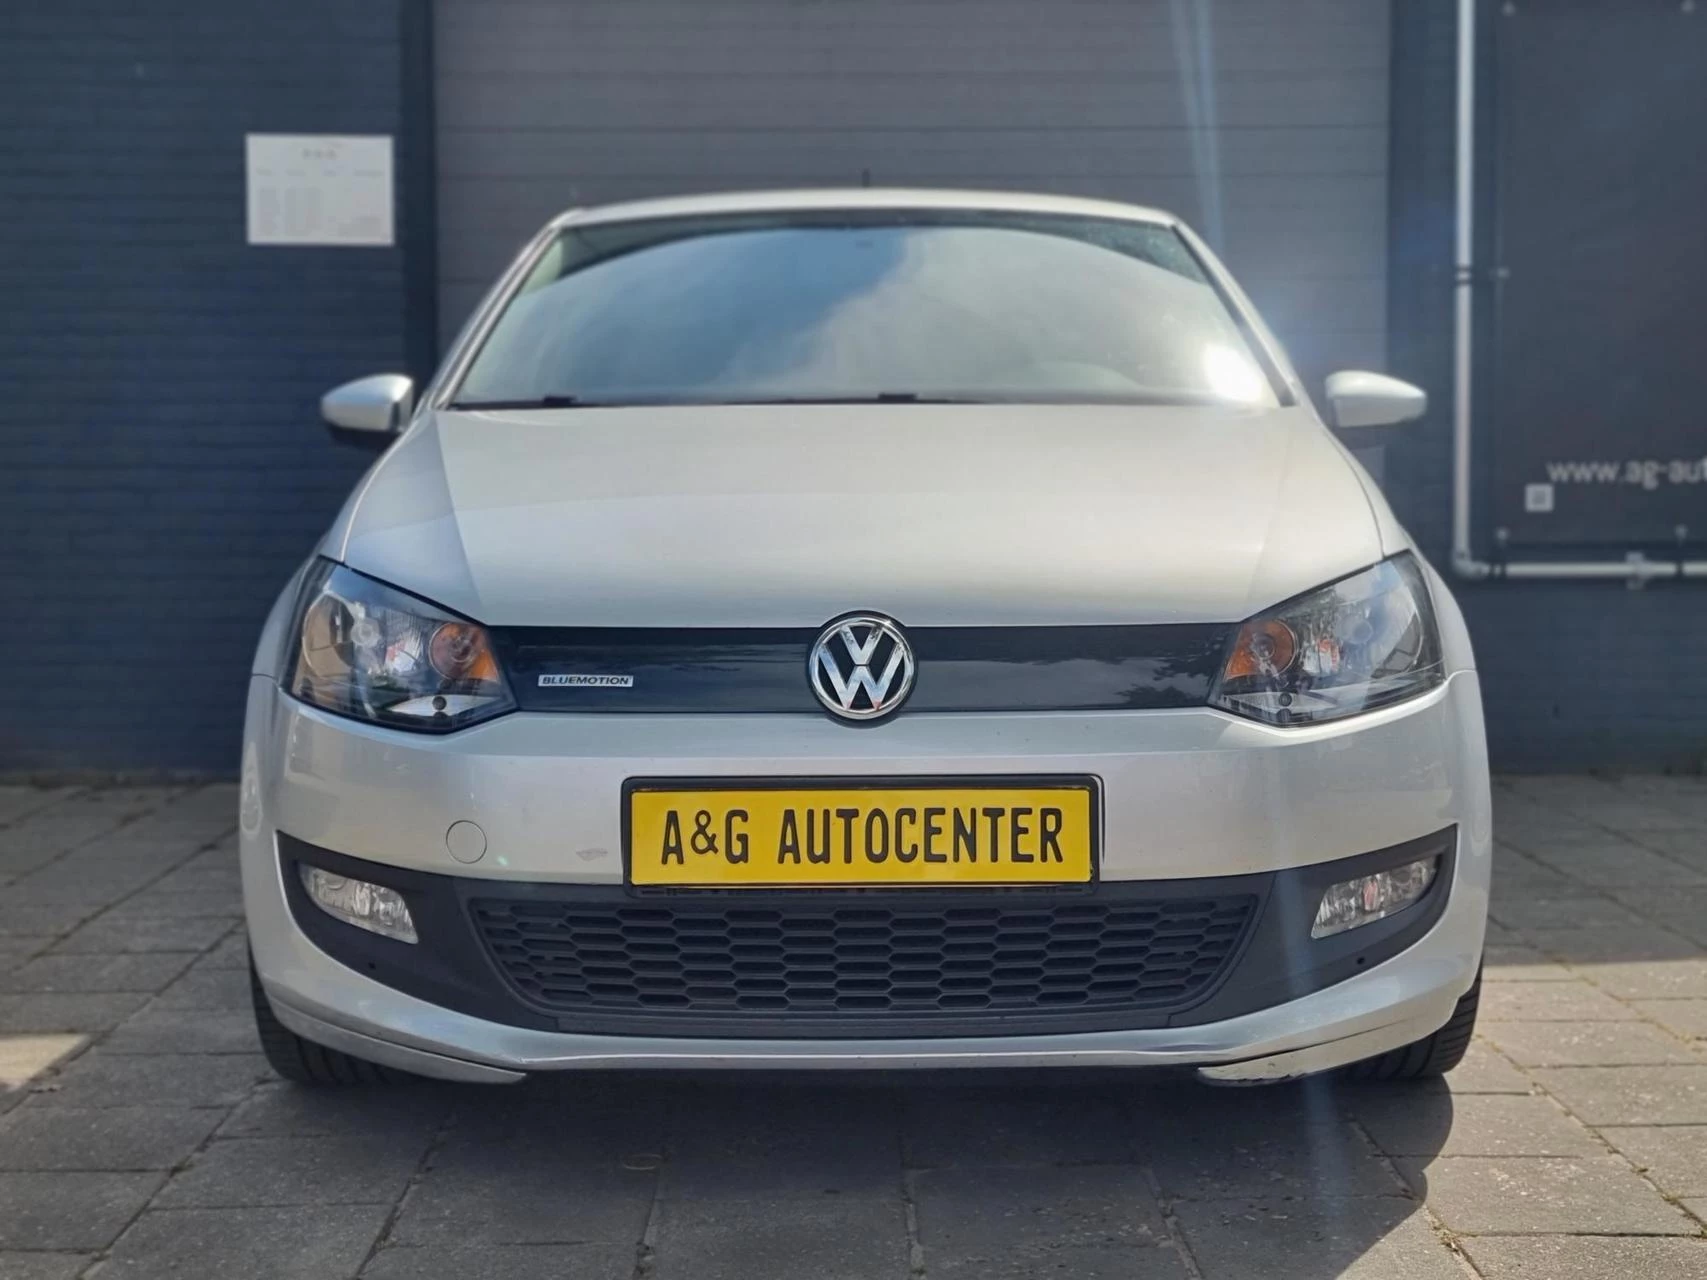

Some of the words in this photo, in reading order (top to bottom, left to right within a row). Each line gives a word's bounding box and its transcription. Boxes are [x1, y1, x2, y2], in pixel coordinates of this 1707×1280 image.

[542, 676, 629, 685] BLUEMOTION
[819, 624, 904, 710] VW
[661, 809, 750, 865] A&G
[777, 807, 1064, 864] AUTOCENTER
